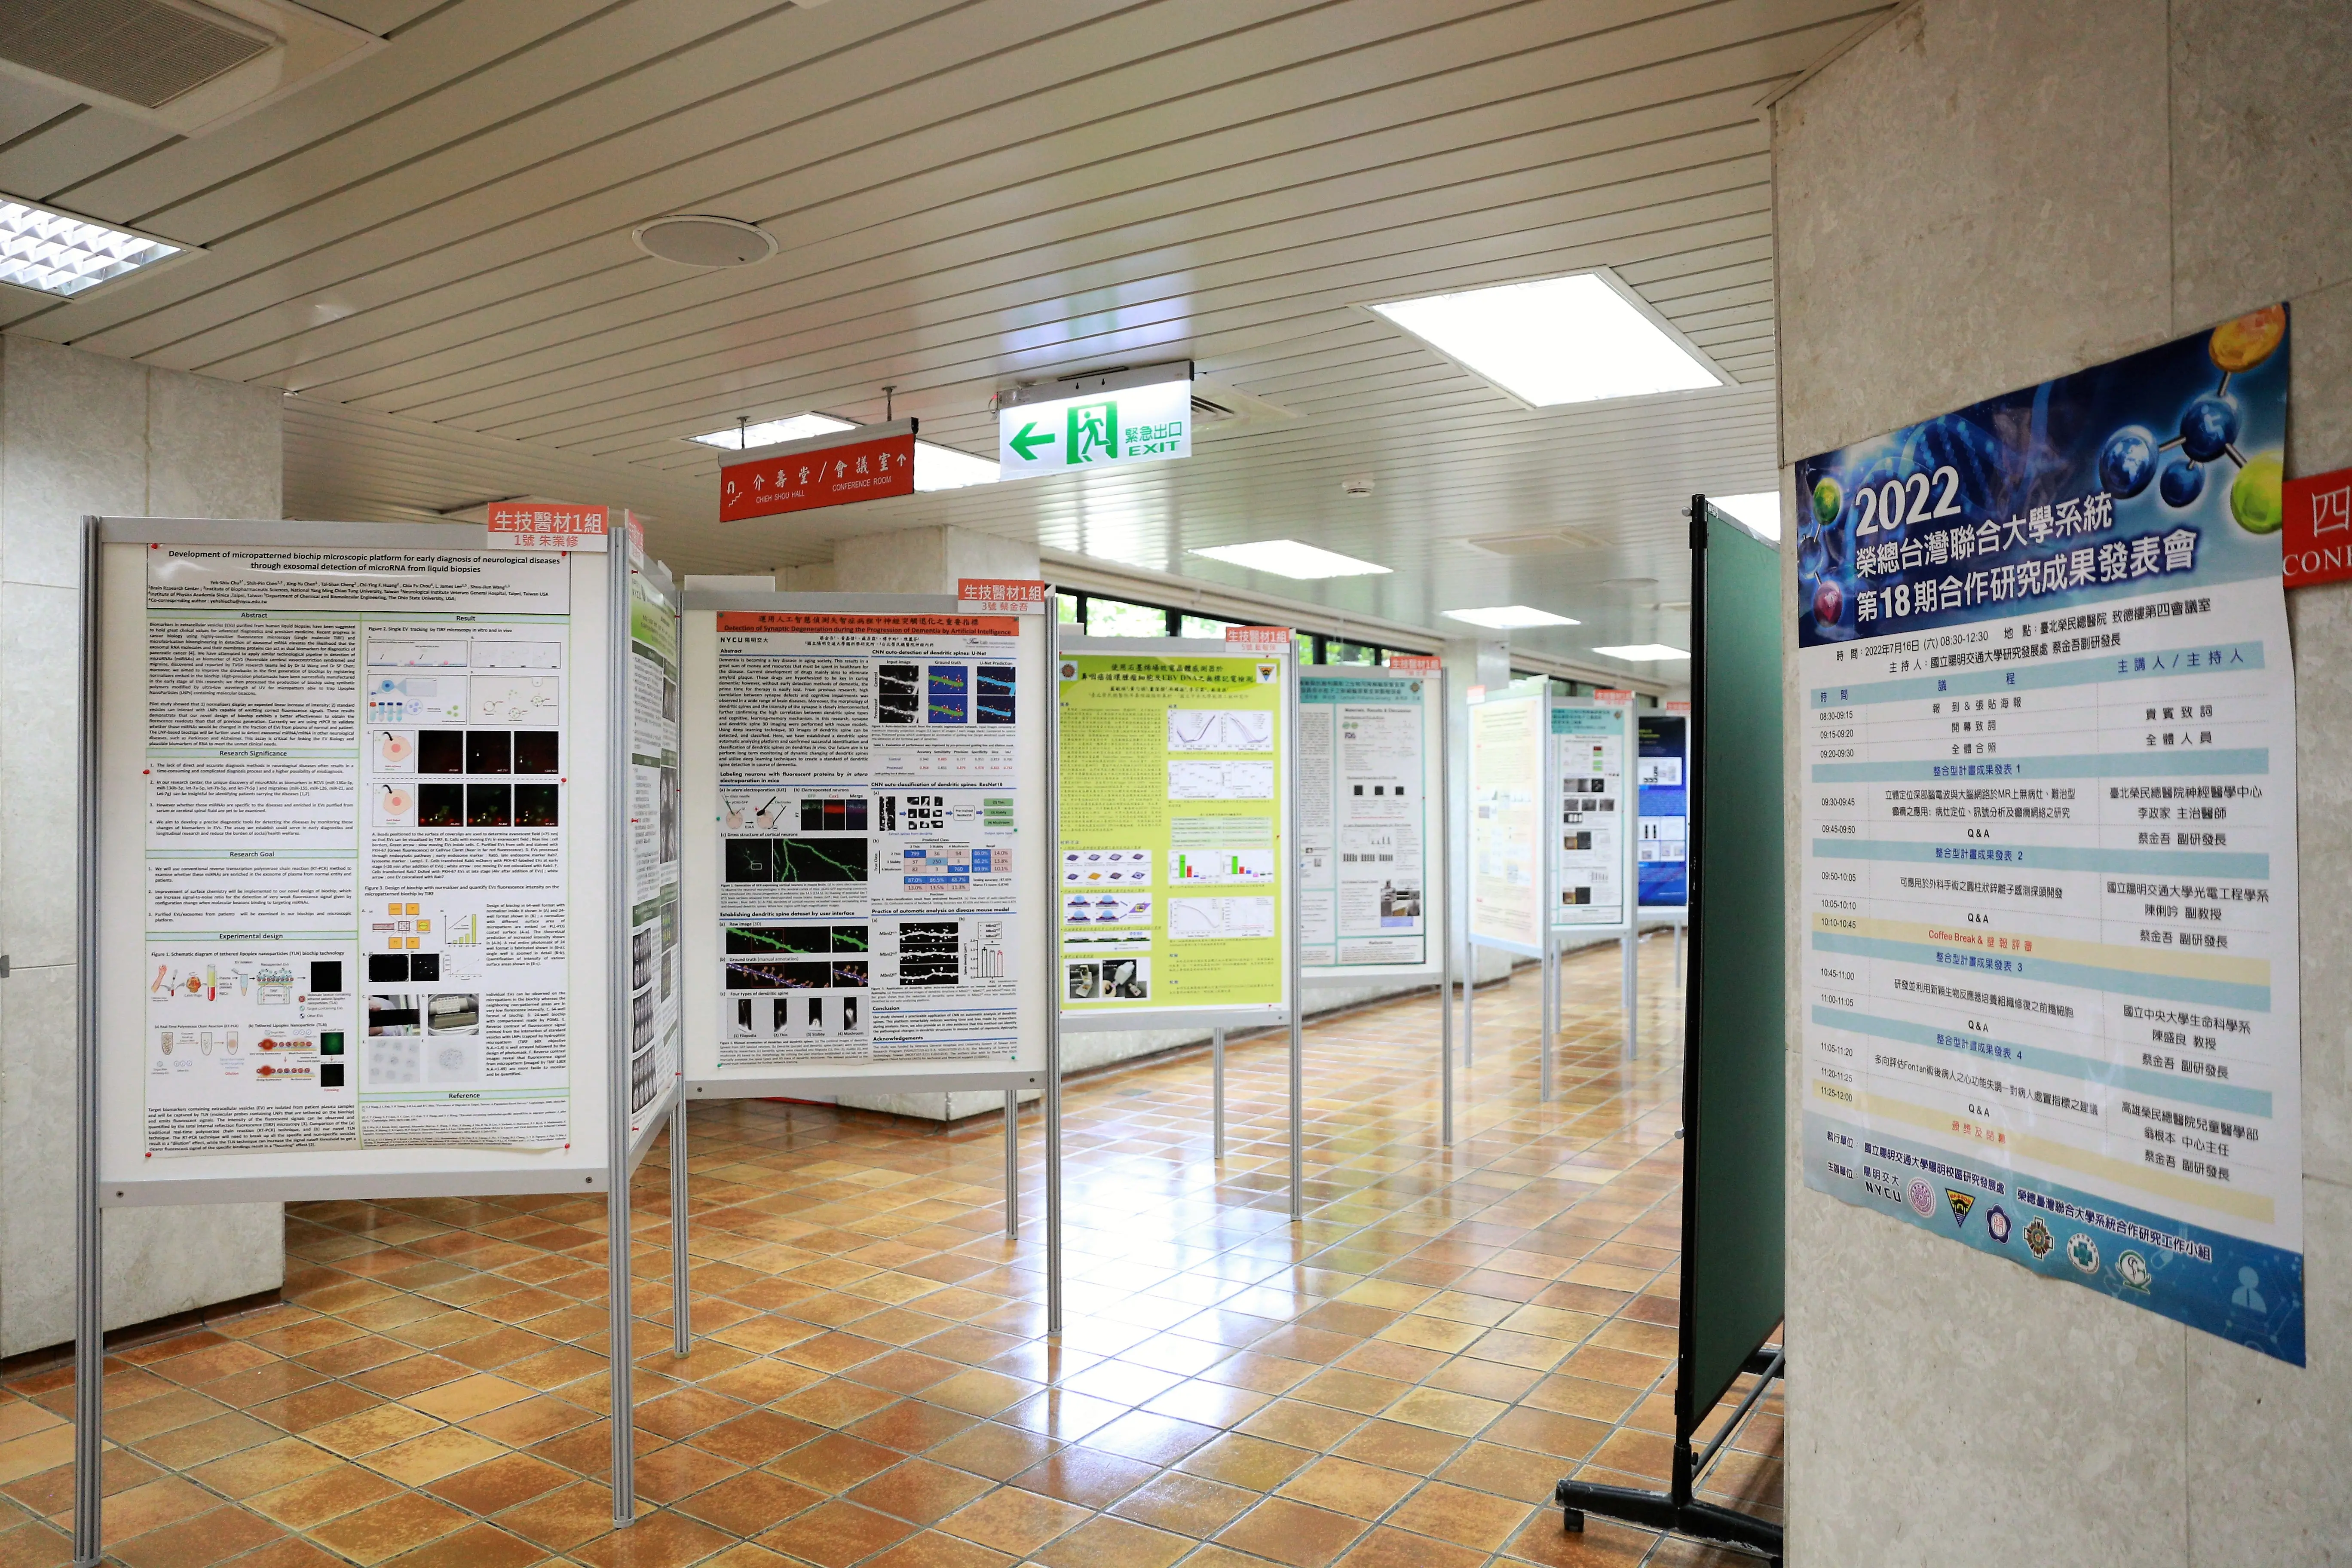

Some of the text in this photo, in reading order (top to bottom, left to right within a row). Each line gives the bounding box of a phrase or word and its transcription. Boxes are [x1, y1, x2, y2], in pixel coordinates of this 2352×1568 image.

[1125, 421, 1182, 444] 緊急出口
[1129, 440, 1180, 456] EXIT
[833, 476, 891, 492] CONFERENCE ROOM
[756, 495, 772, 503] CHIEH
[775, 492, 789, 501] SHOU
[1856, 465, 1961, 536] 2022
[2312, 485, 2350, 537] 四
[495, 511, 602, 533] 生技醫材1組
[514, 535, 578, 546] 1號 朱業修
[1856, 491, 2113, 579] 榮總台灣聯合大學系統
[169, 550, 220, 559] Development
[232, 552, 291, 560] micropatterned
[294, 552, 321, 561] biochip
[323, 553, 367, 561] microscopic
[417, 556, 435, 564] early
[437, 556, 471, 564] diagnosis
[483, 557, 527, 565] neurological
[251, 562, 281, 571] through
[428, 565, 448, 573] liquid
[450, 566, 481, 574] biopsies
[1856, 528, 2197, 623] 第18期合作研究成果發表會
[964, 584, 1041, 601] 生技醫材1組
[1941, 631, 1988, 646] 08:30-12:30
[2053, 632, 2121, 654] 蔡金吾副研發長
[1820, 711, 1853, 720] 08:30-09:15
[1820, 729, 1853, 739] 09:15-09:20
[1820, 749, 1854, 758] 09:20-09:30
[1821, 797, 1855, 807] 09:30-09:45
[2177, 808, 2226, 820] 主治醫師
[1822, 825, 1855, 834] 09:45-09:50
[2138, 833, 2226, 846] 蔡金吾 副研發長
[2018, 851, 2023, 861] 2
[1821, 871, 1856, 882] 09:50-10:05
[1821, 899, 1856, 910] 10:05-10:10
[2185, 906, 2221, 920] 副教授
[1821, 918, 1856, 929] 10:10-10:45
[1929, 930, 1952, 941] Coffee
[1954, 933, 1975, 943] Break
[2141, 929, 2228, 949] 蔡金吾 副研發長
[1821, 968, 1855, 980] 10:45-11:00
[2018, 963, 2023, 972] 3
[1821, 994, 1854, 1007] 11:00-11:05
[2124, 1004, 2251, 1034] 國立中央大學生命科學系
[1821, 1042, 1853, 1057] 11:05-11:20
[2193, 1035, 2216, 1050] 教授
[2017, 1051, 2022, 1060] 4
[2142, 1053, 2229, 1079] 蔡金吾 副研發長
[1821, 1068, 1853, 1082] 11:20-11:25
[1821, 1087, 1853, 1102] 11:25-12:00
[2182, 1136, 2230, 1156] 中心主任
[2145, 1149, 2230, 1181] 蔡金吾 副研發長
[1865, 1181, 1902, 1203] NYCU
